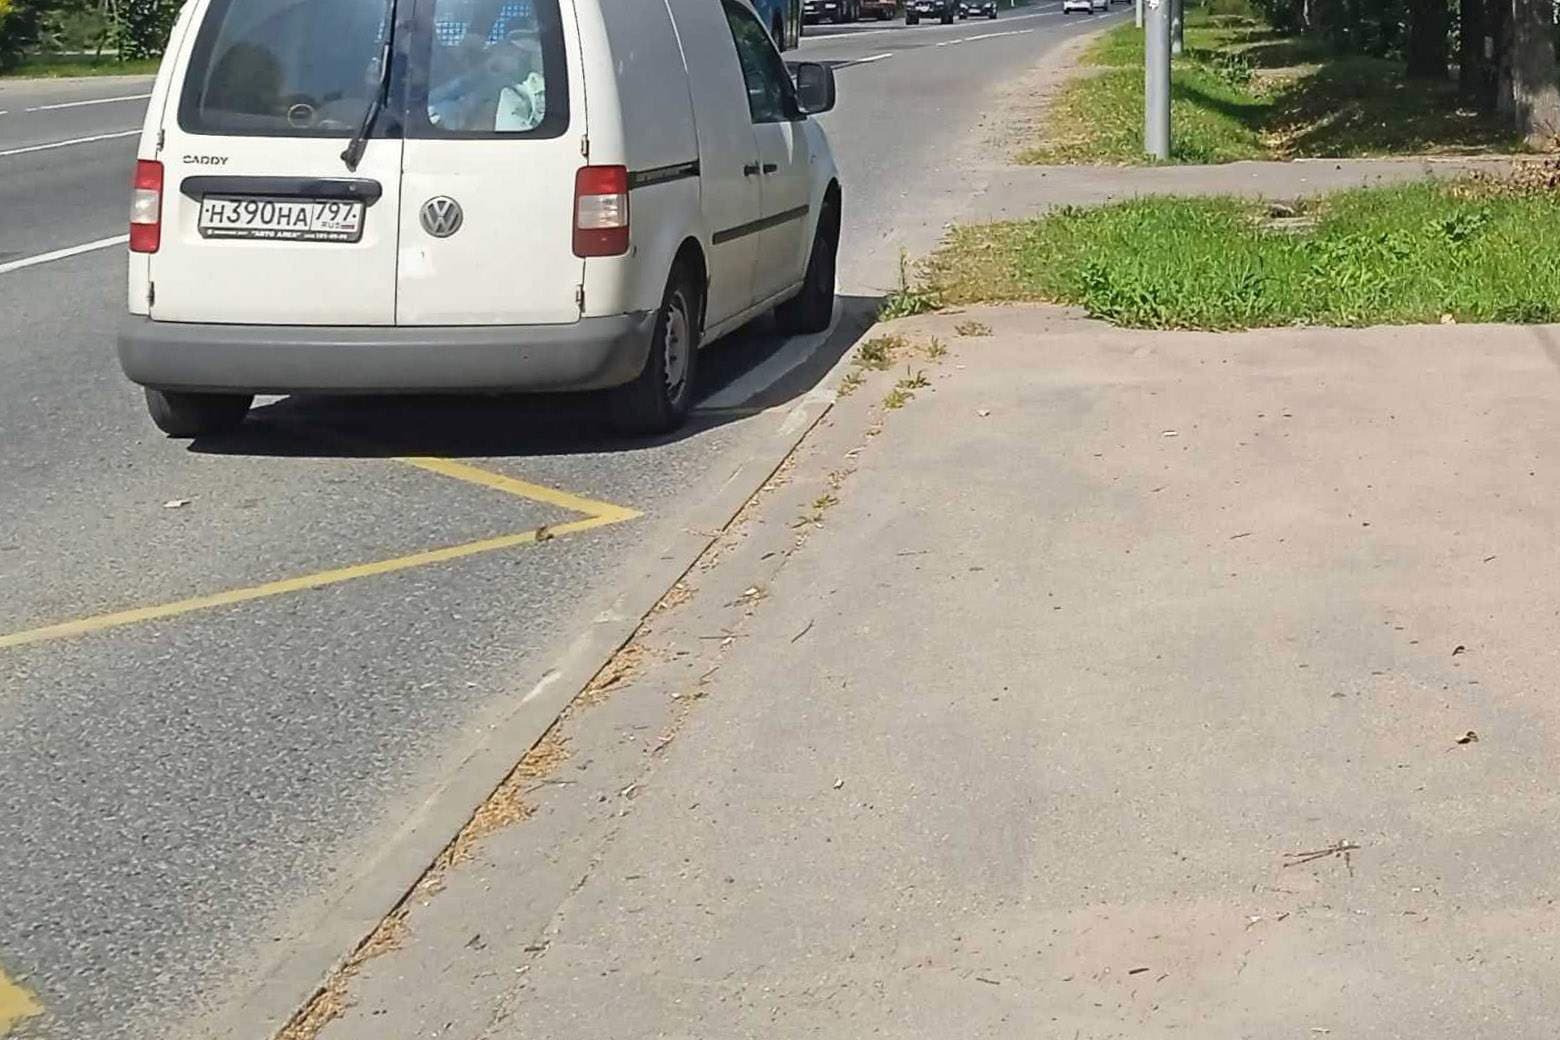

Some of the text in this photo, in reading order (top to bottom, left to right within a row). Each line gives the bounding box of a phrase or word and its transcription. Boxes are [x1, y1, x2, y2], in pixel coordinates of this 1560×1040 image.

[183, 155, 229, 165] CADDY
[209, 201, 355, 226] Н390НА 797
